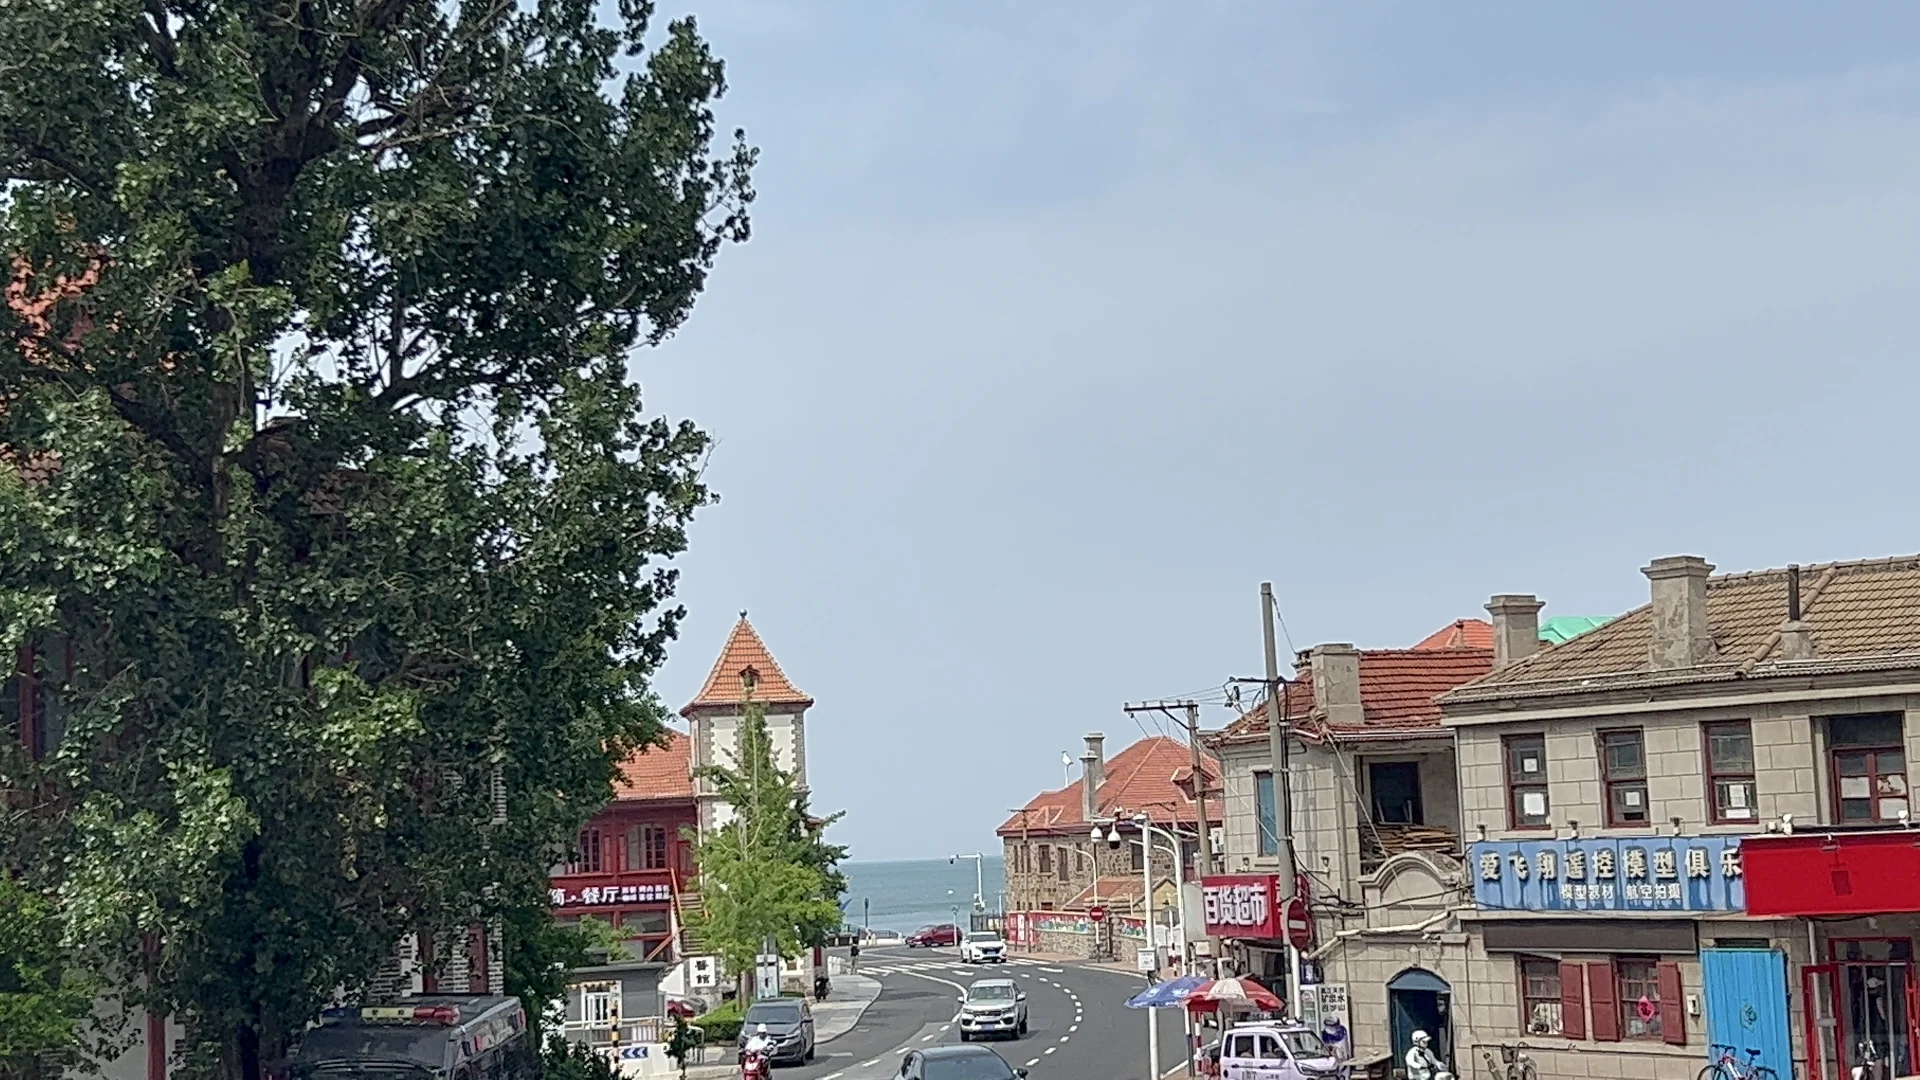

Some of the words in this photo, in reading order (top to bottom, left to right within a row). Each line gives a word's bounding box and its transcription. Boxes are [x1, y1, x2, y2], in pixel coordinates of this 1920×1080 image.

[1479, 847, 1742, 880] 爱飞翔遥控模型俱乐
[1203, 883, 1267, 926] 百货超市
